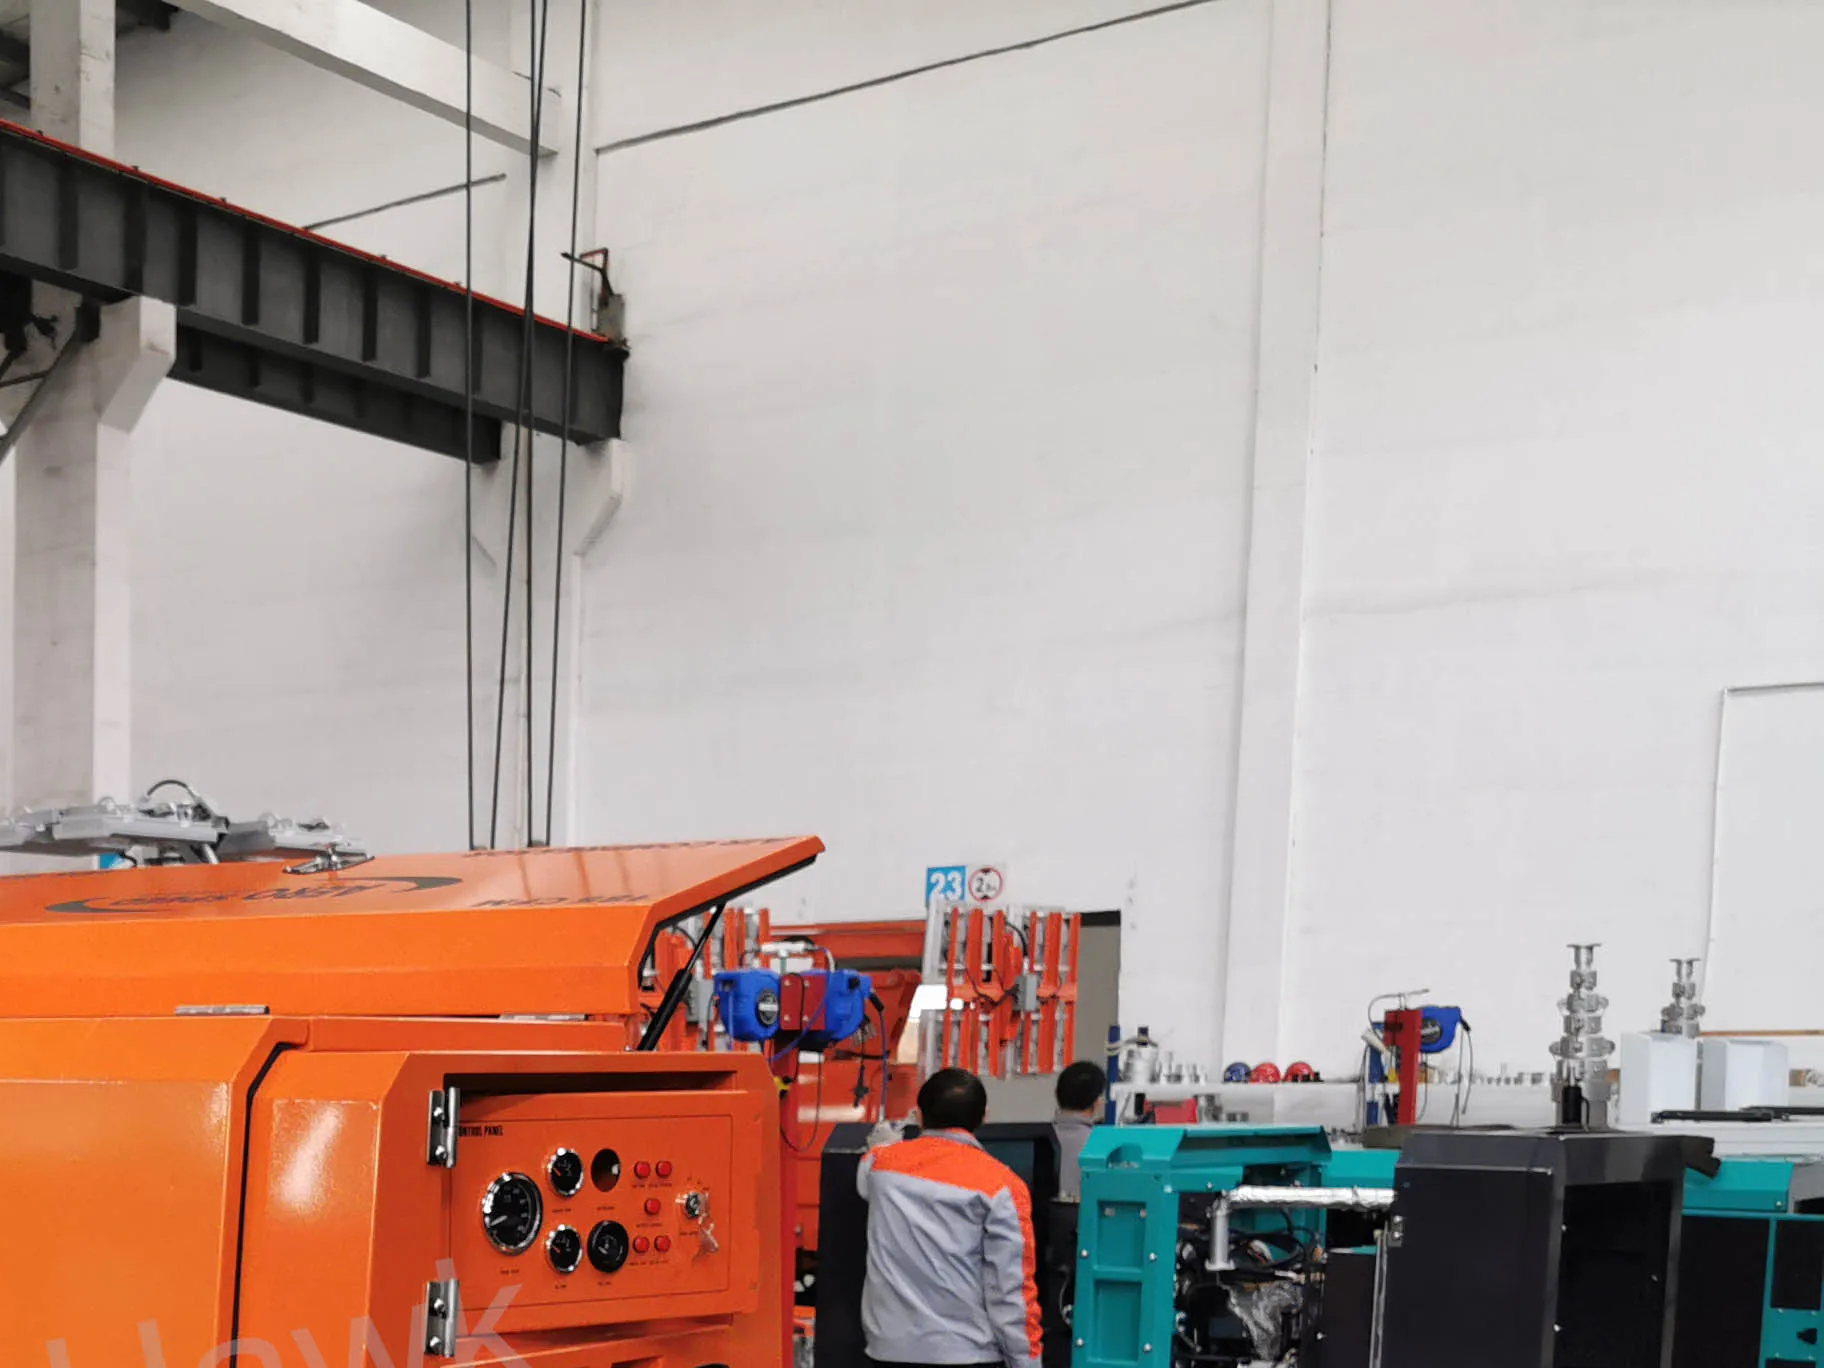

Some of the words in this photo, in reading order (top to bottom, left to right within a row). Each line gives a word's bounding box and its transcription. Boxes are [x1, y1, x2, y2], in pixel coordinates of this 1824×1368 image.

[931, 871, 962, 900] 23
[458, 1125, 483, 1138] ONTROL
[484, 1125, 504, 1138] PANEL
